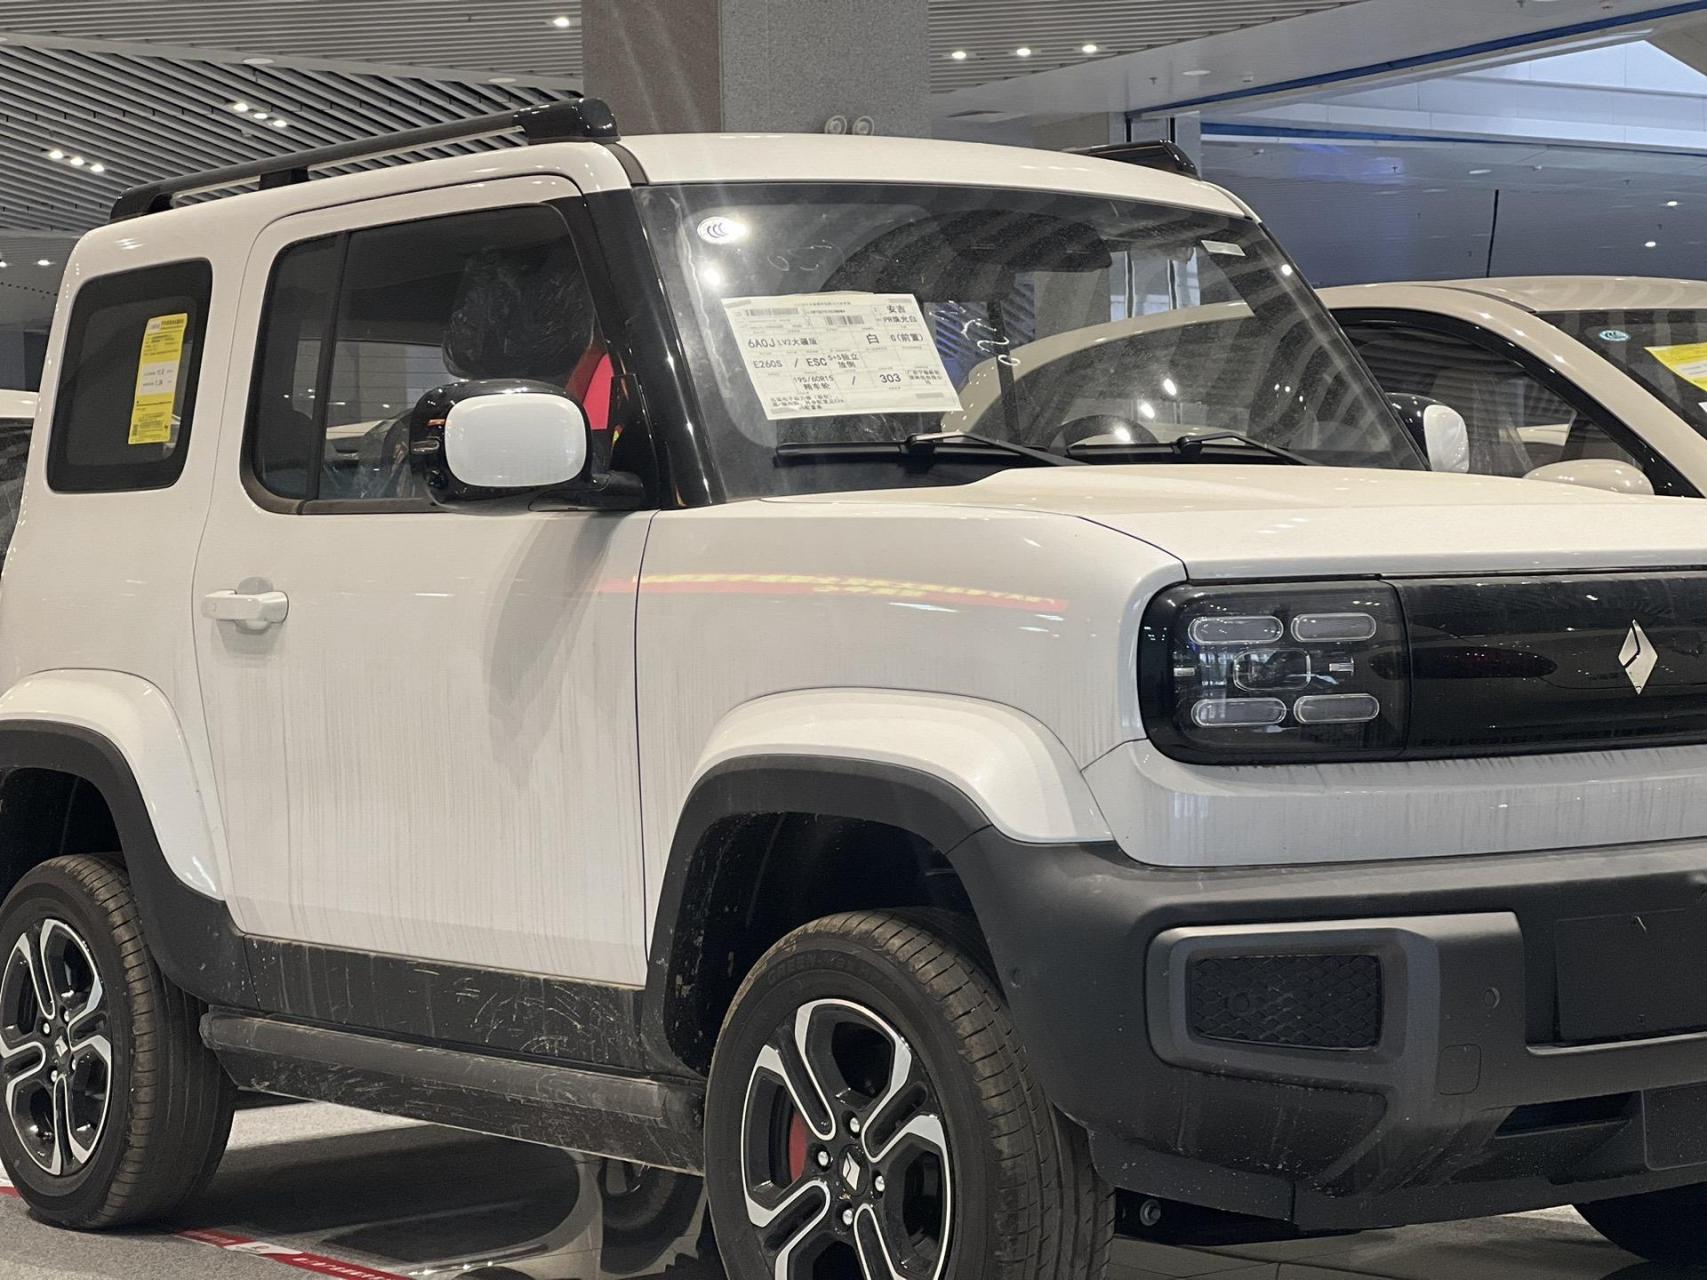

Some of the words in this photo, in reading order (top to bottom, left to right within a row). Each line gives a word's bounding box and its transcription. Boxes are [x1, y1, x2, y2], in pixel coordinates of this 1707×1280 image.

[866, 333, 880, 345] 白
[806, 357, 828, 367] ESC
[879, 373, 902, 384] 303
